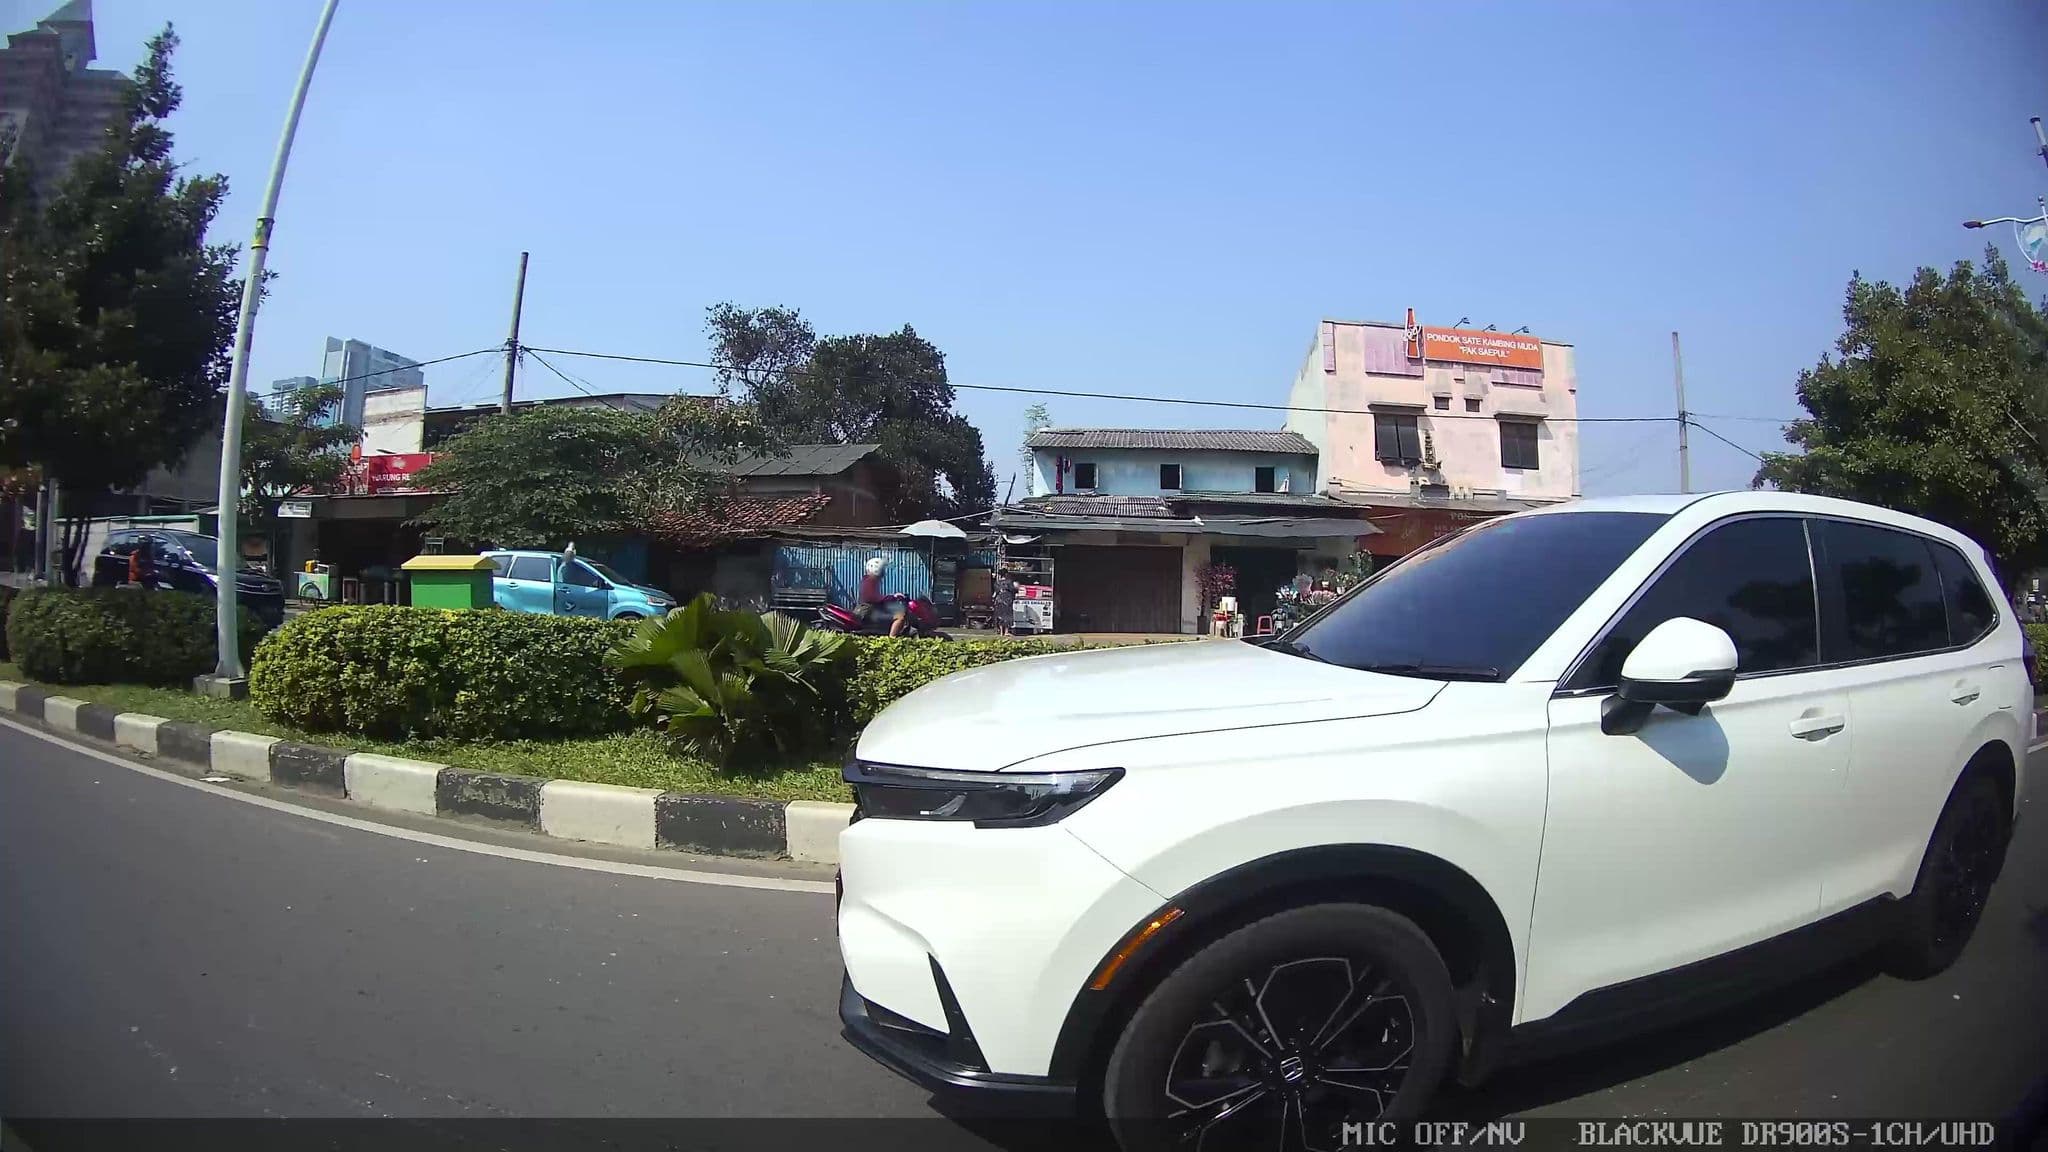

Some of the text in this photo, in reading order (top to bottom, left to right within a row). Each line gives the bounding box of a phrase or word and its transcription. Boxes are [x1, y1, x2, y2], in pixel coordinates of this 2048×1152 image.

[1427, 333, 1539, 352] PONDOK SATE KAMBING MUDA
